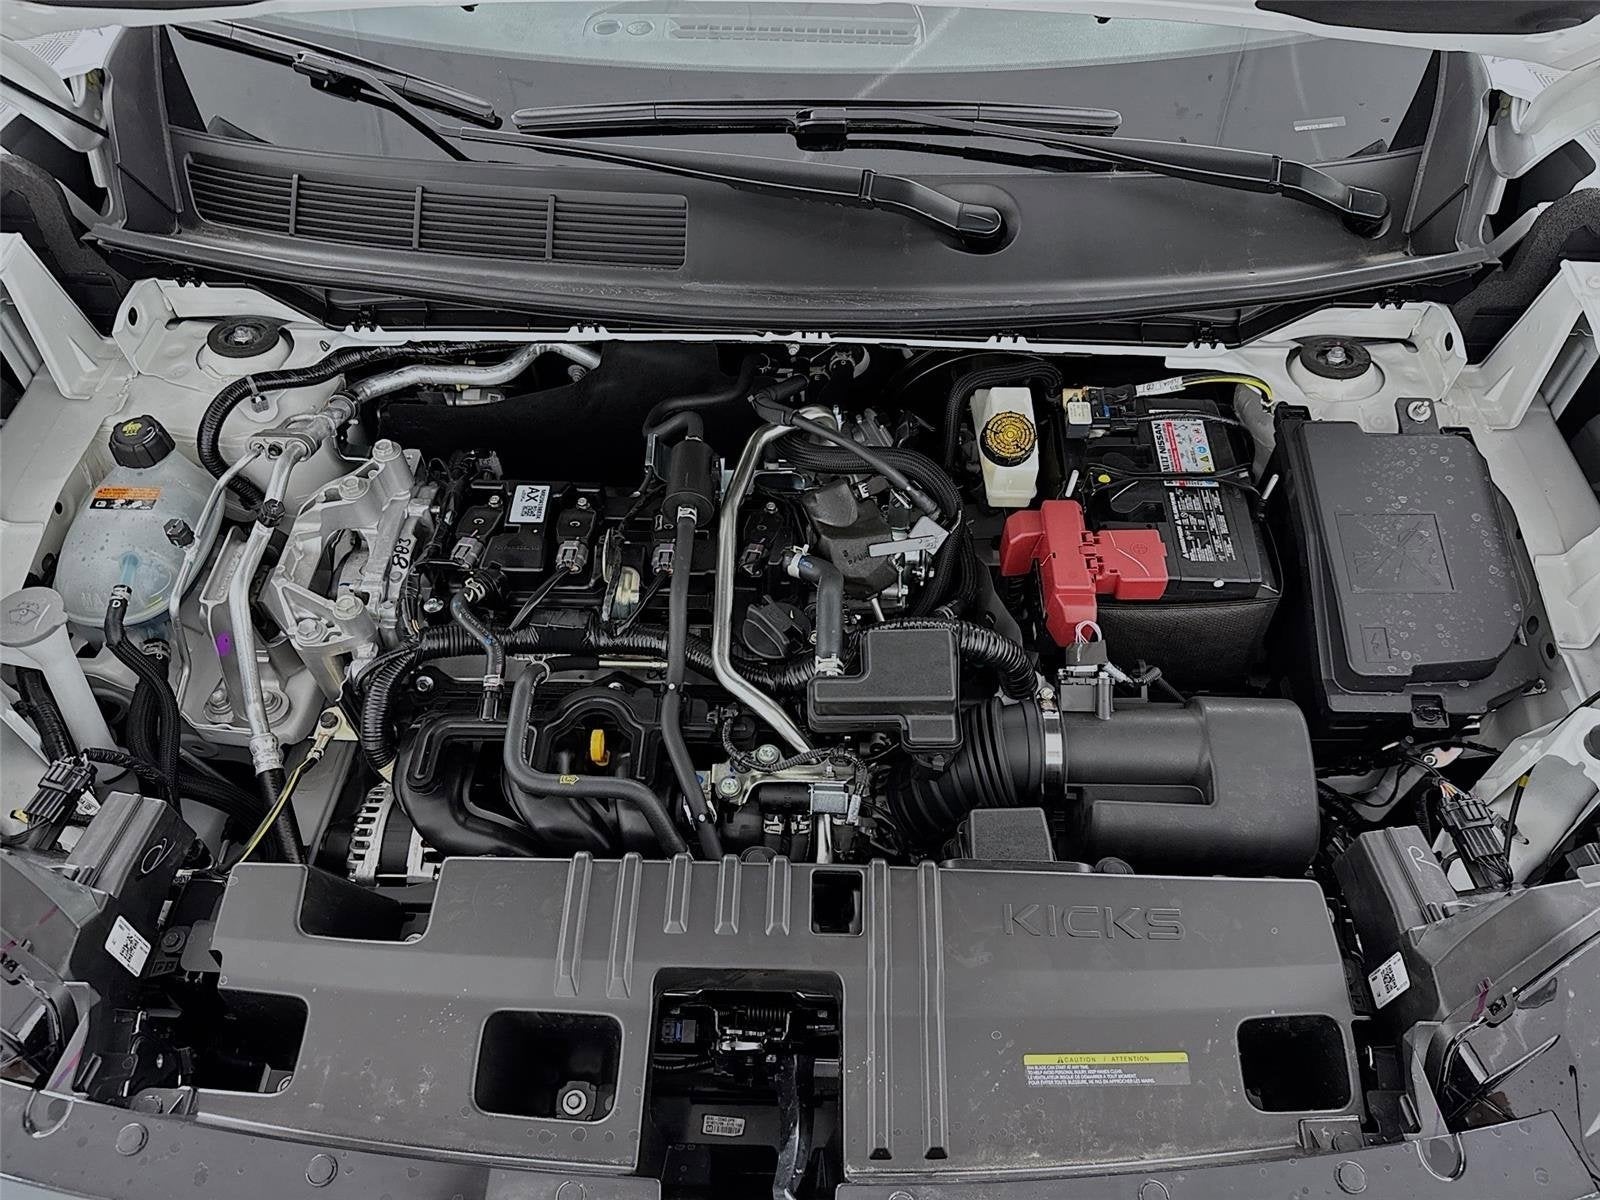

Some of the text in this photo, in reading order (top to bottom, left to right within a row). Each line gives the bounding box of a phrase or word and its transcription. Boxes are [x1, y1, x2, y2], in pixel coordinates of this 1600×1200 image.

[1154, 423, 1167, 454] NISSAN
[525, 486, 540, 502] AX
[1408, 846, 1442, 872] R
[1002, 903, 1185, 941] KICKS
